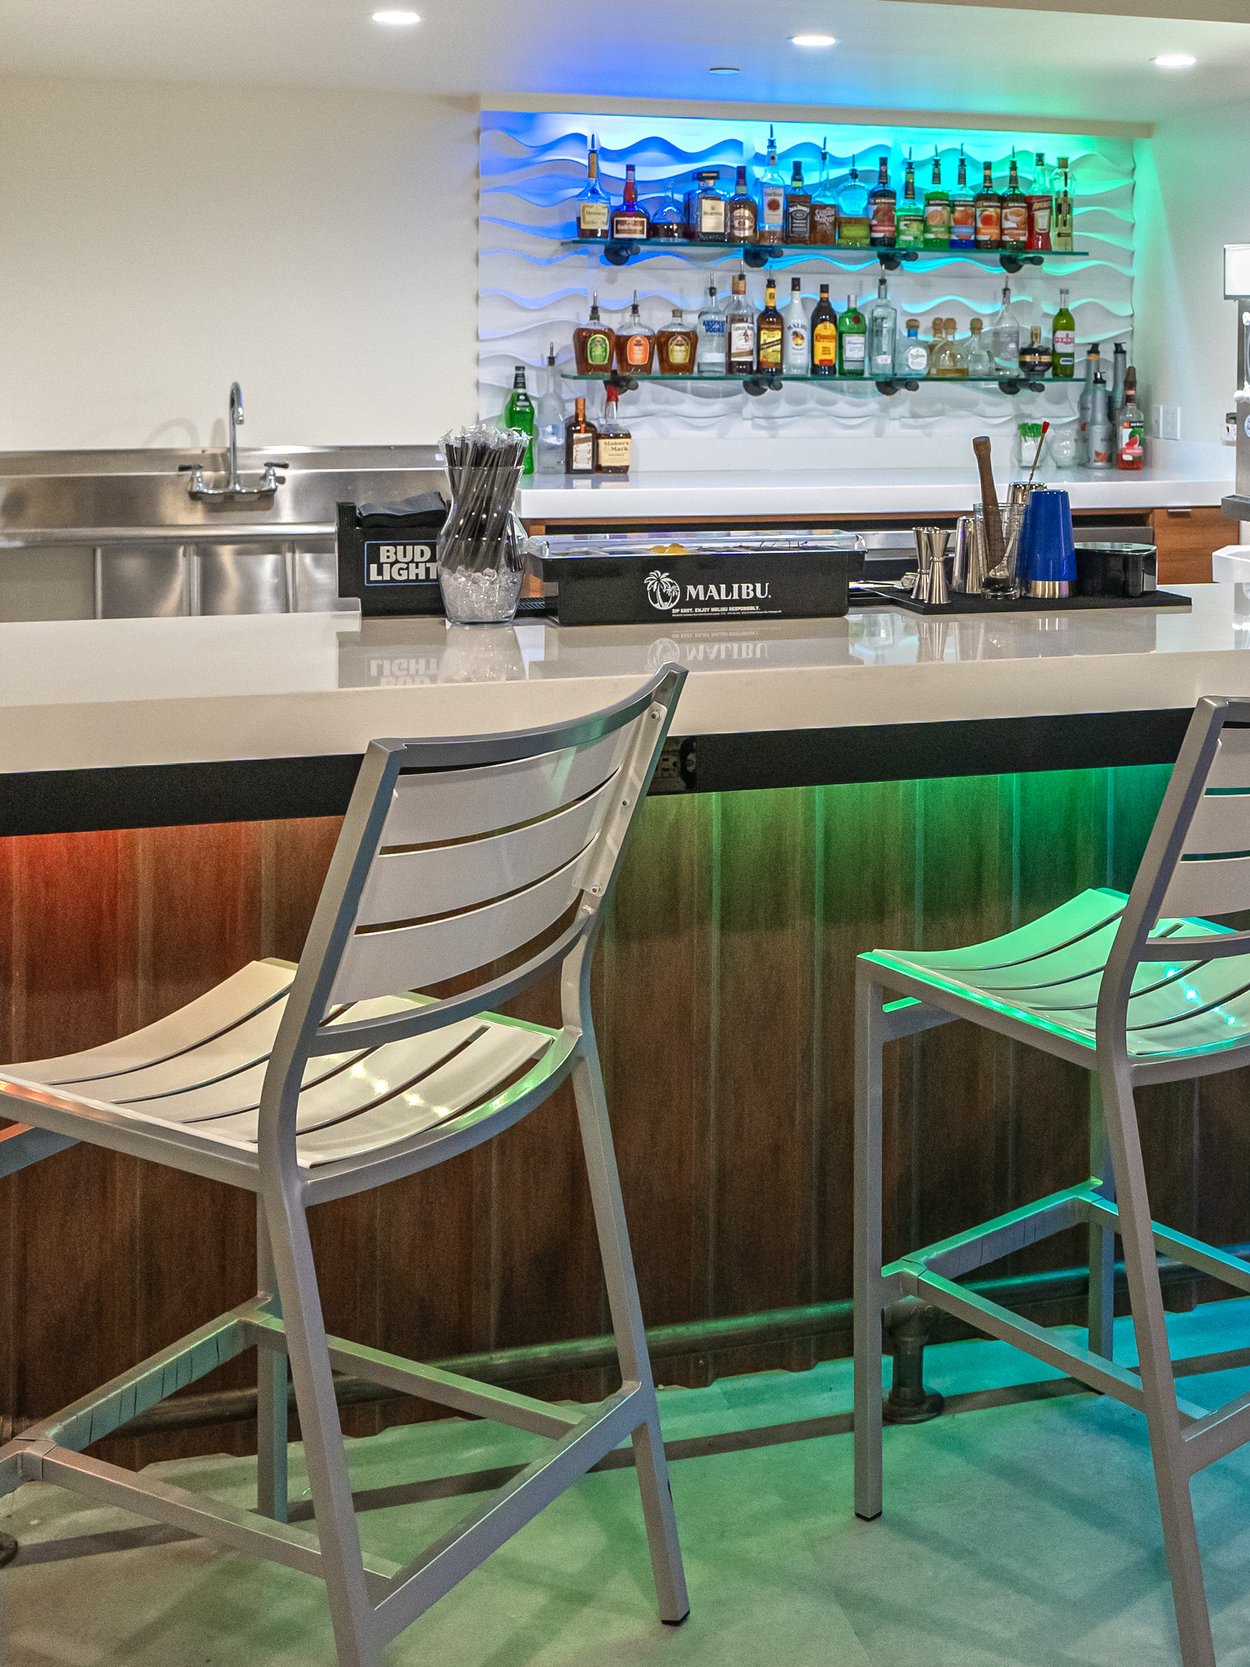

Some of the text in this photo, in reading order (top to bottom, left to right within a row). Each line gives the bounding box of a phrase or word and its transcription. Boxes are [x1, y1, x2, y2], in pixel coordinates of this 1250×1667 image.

[379, 545, 432, 563] BUD
[369, 563, 439, 581] LIGHT
[686, 583, 770, 601] MALIBU
